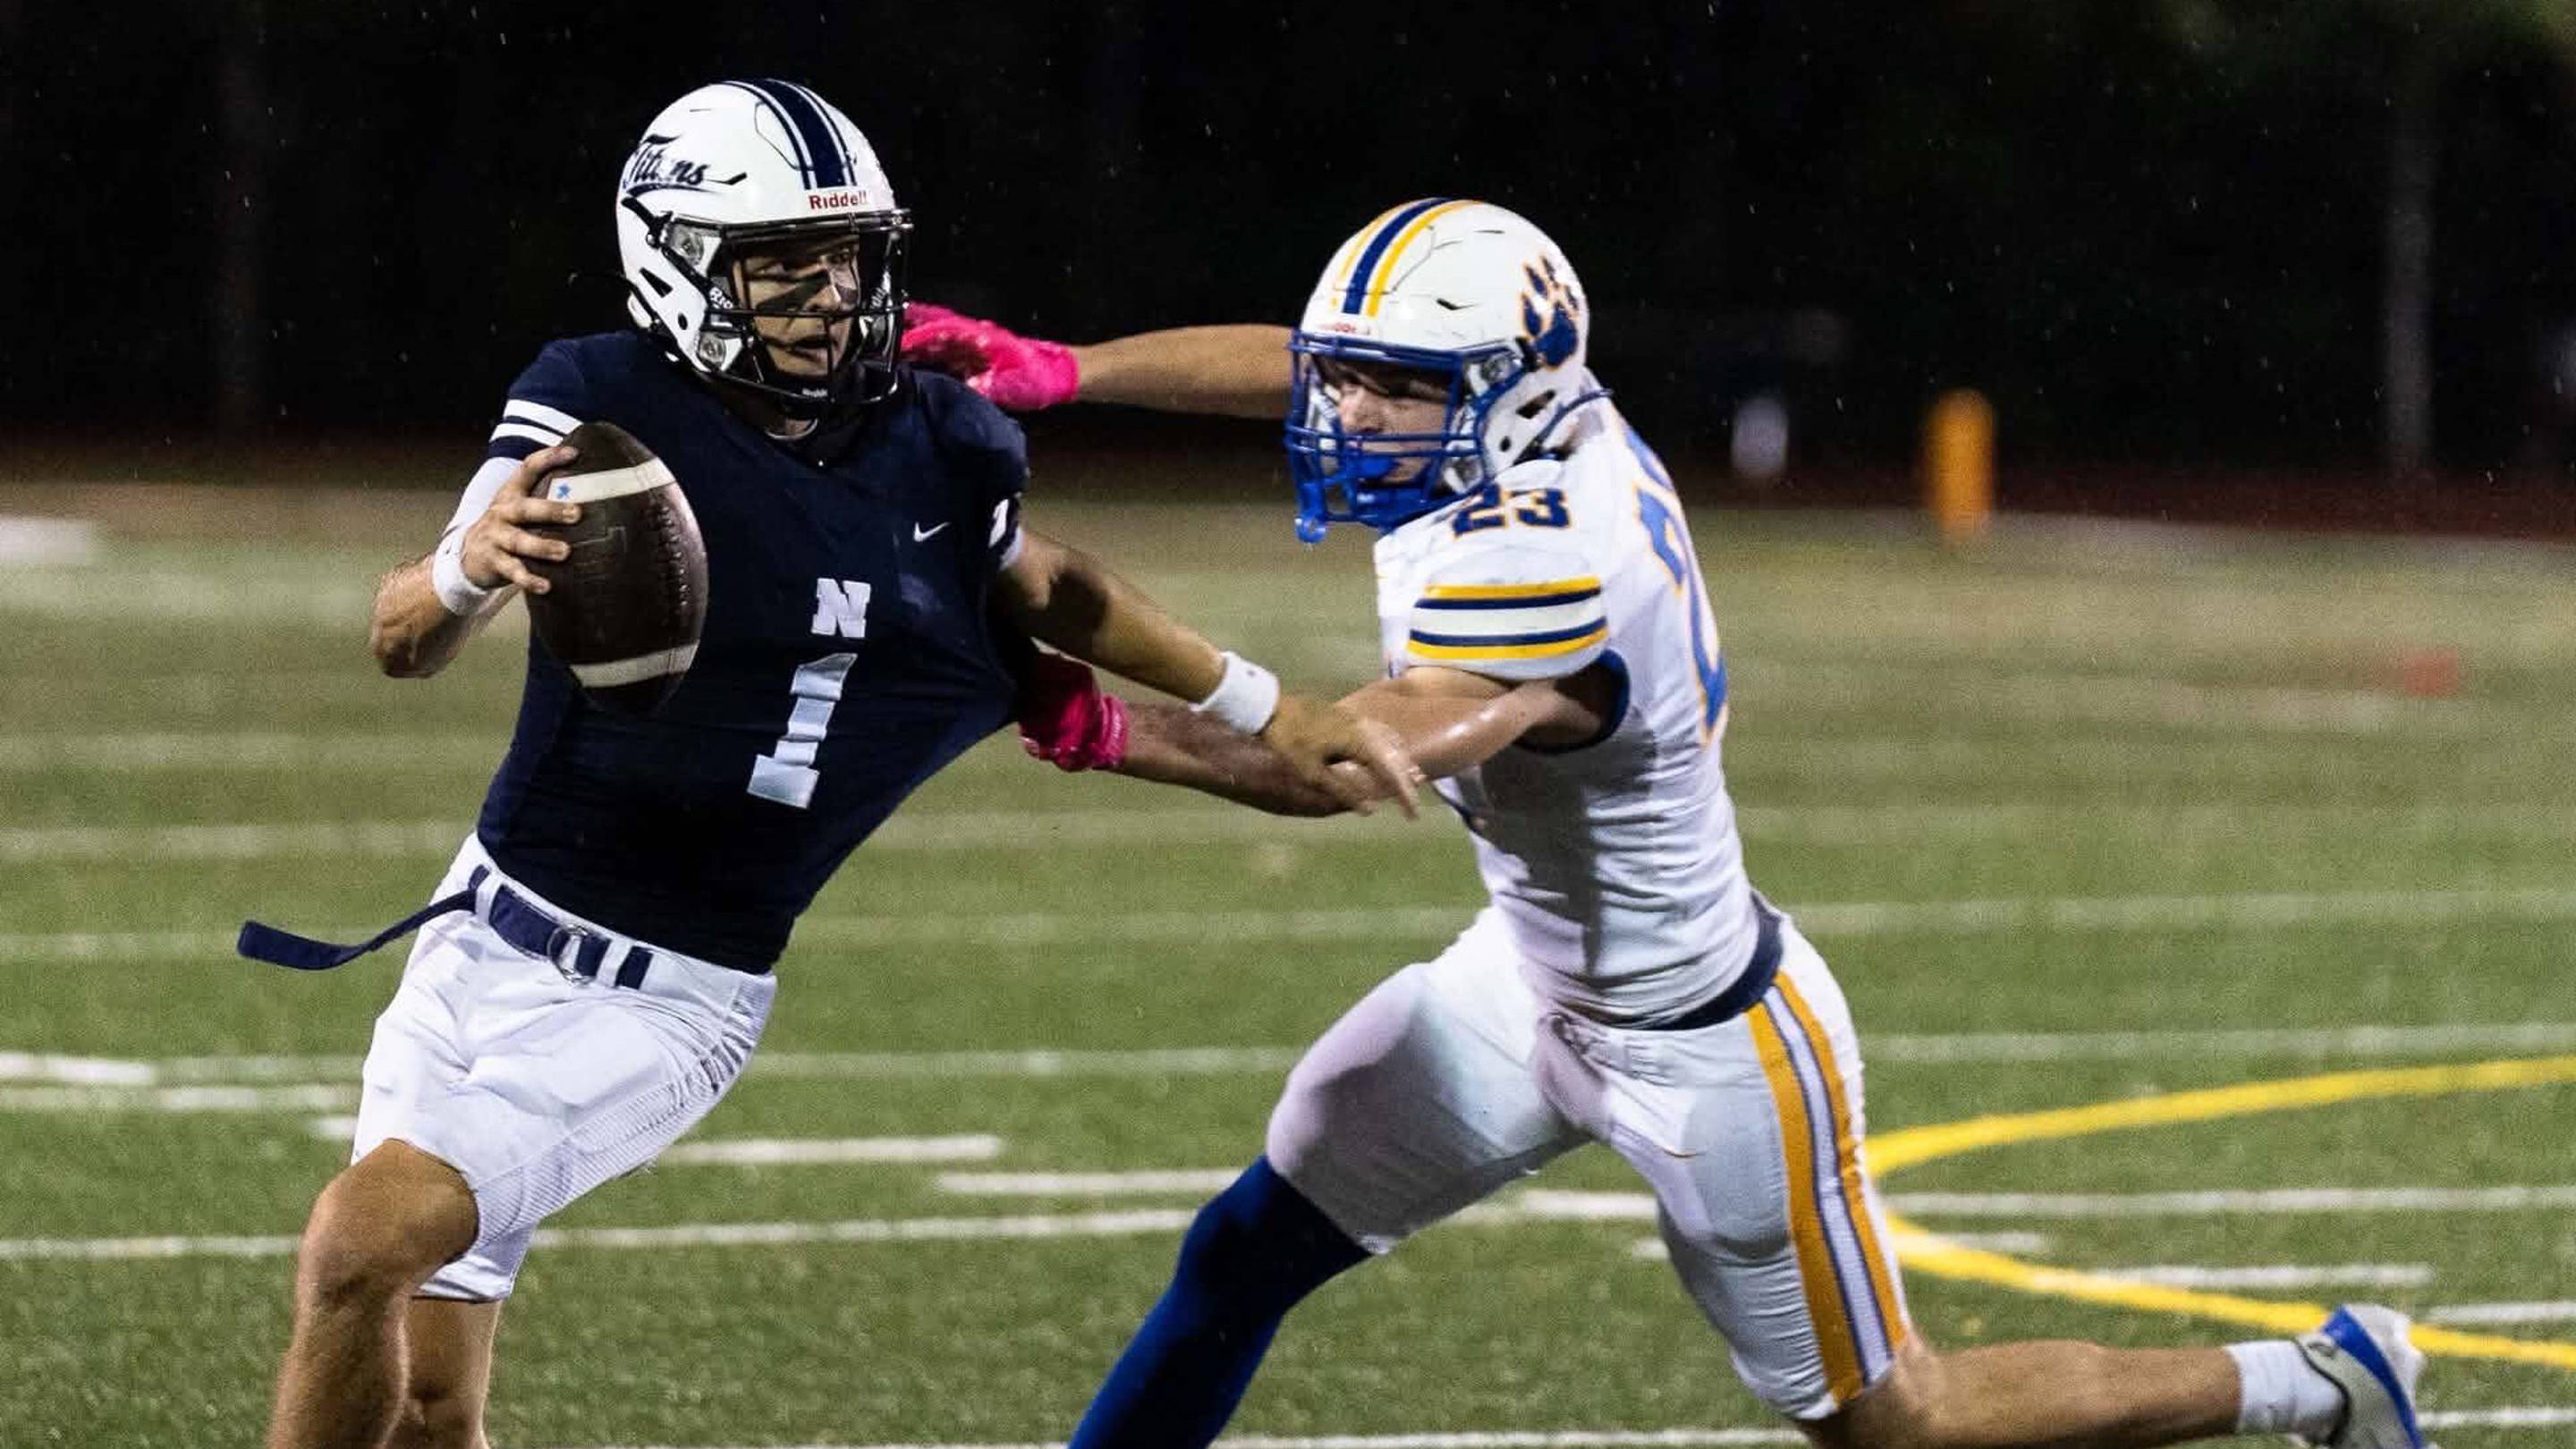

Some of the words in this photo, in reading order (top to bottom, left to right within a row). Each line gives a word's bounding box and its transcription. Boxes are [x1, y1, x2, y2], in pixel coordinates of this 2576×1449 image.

[624, 133, 712, 194] Titns
[1452, 483, 1573, 539] 23
[811, 578, 871, 638] N
[747, 652, 859, 809] 1
